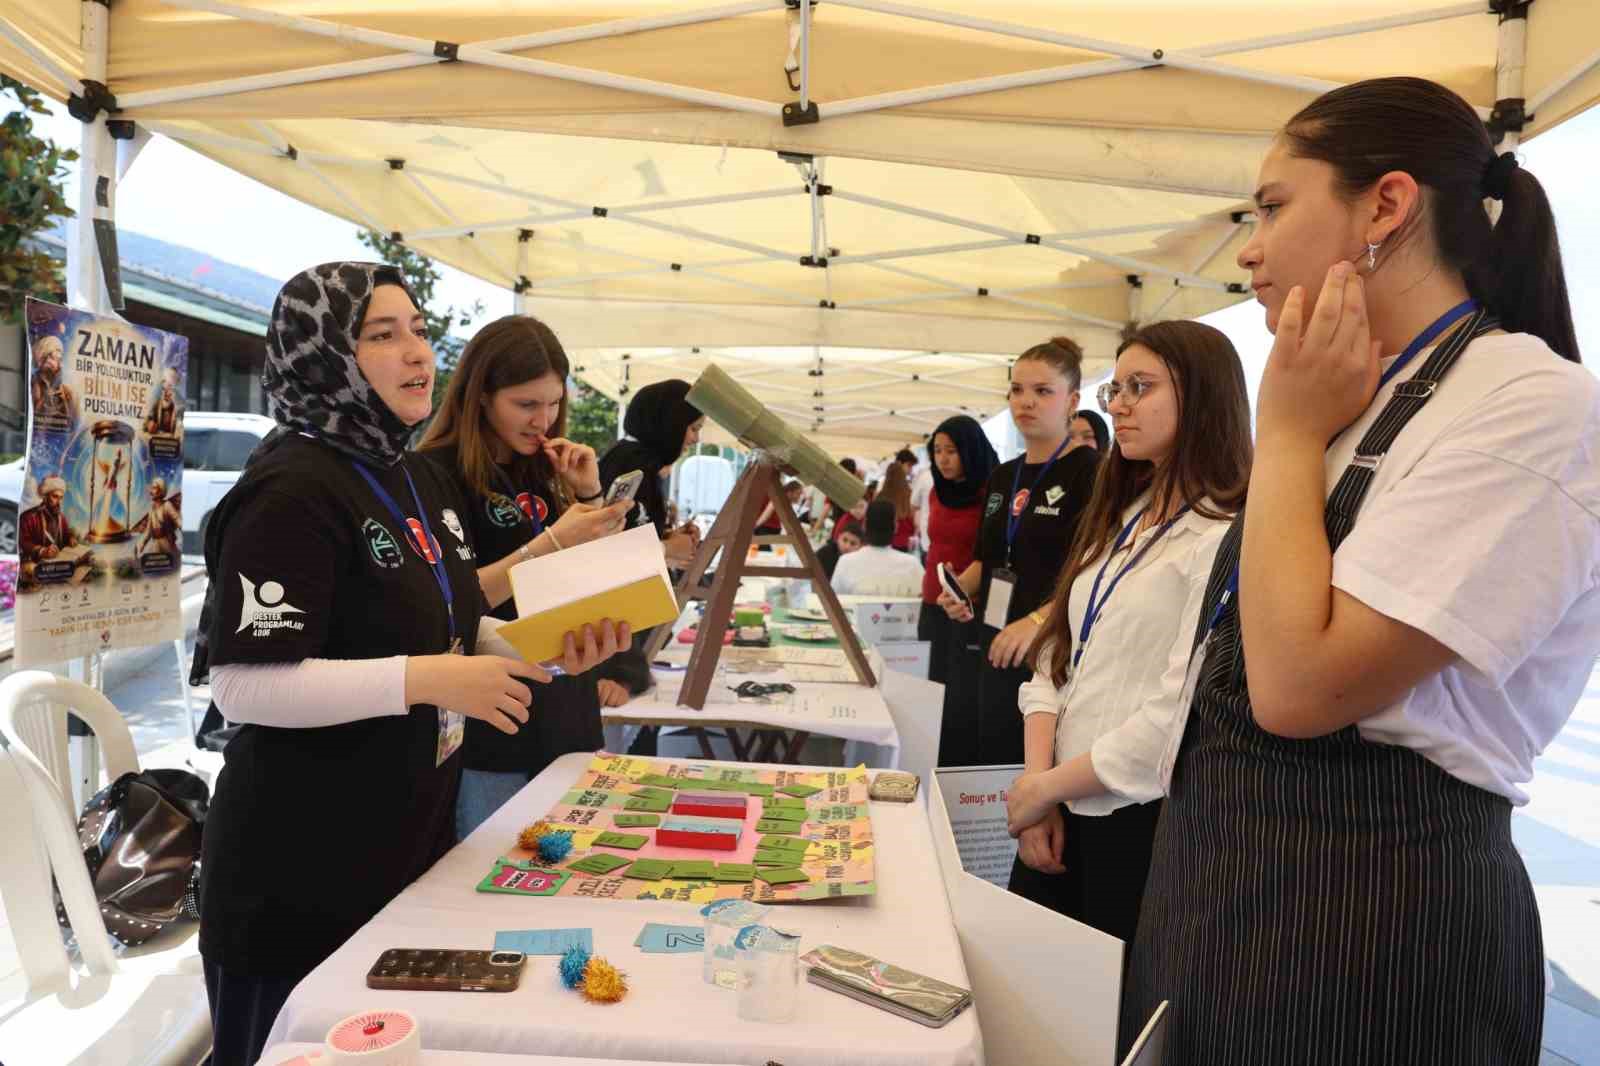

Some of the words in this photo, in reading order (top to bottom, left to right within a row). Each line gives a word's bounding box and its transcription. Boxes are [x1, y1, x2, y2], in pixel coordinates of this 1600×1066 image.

[78, 329, 156, 370] ZAMAN
[76, 358, 93, 373] BİR
[253, 620, 305, 631] PROGRAMLARI
[960, 792, 985, 806] Sonuç
[987, 794, 997, 803] ve
